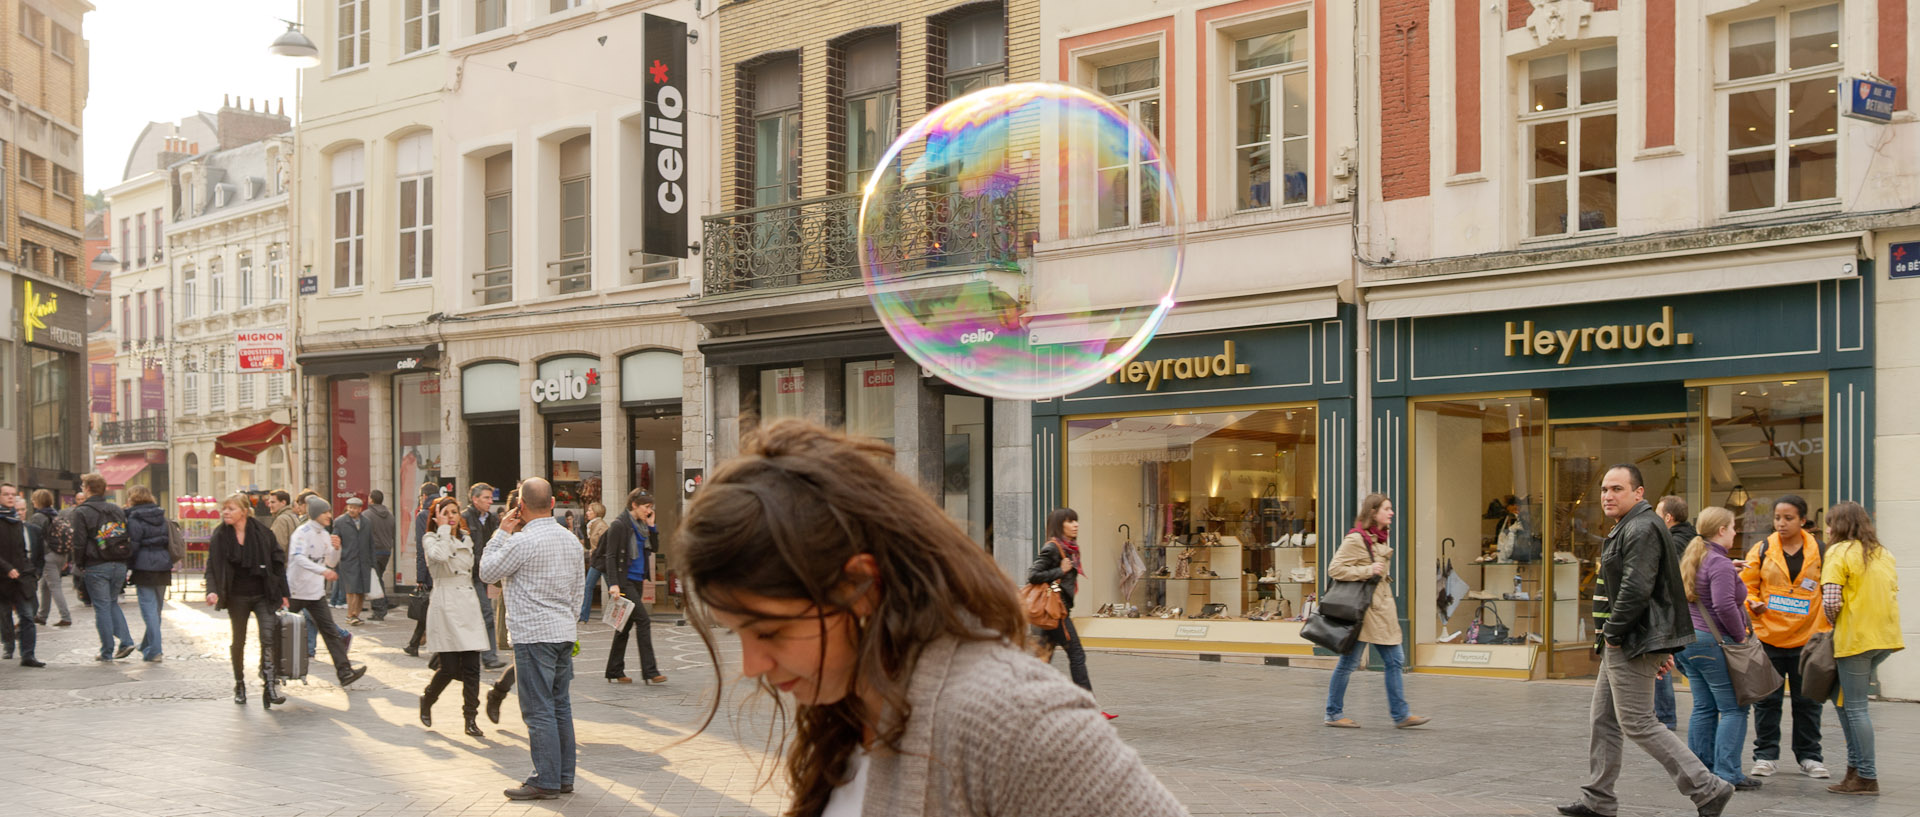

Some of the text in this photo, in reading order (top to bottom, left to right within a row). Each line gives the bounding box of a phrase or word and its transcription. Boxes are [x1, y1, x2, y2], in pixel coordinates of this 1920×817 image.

[1896, 260, 1920, 272] de BÉ
[238, 333, 282, 341] MIGNON
[868, 372, 894, 384] celio
[1770, 595, 1809, 607] HANDICAP
